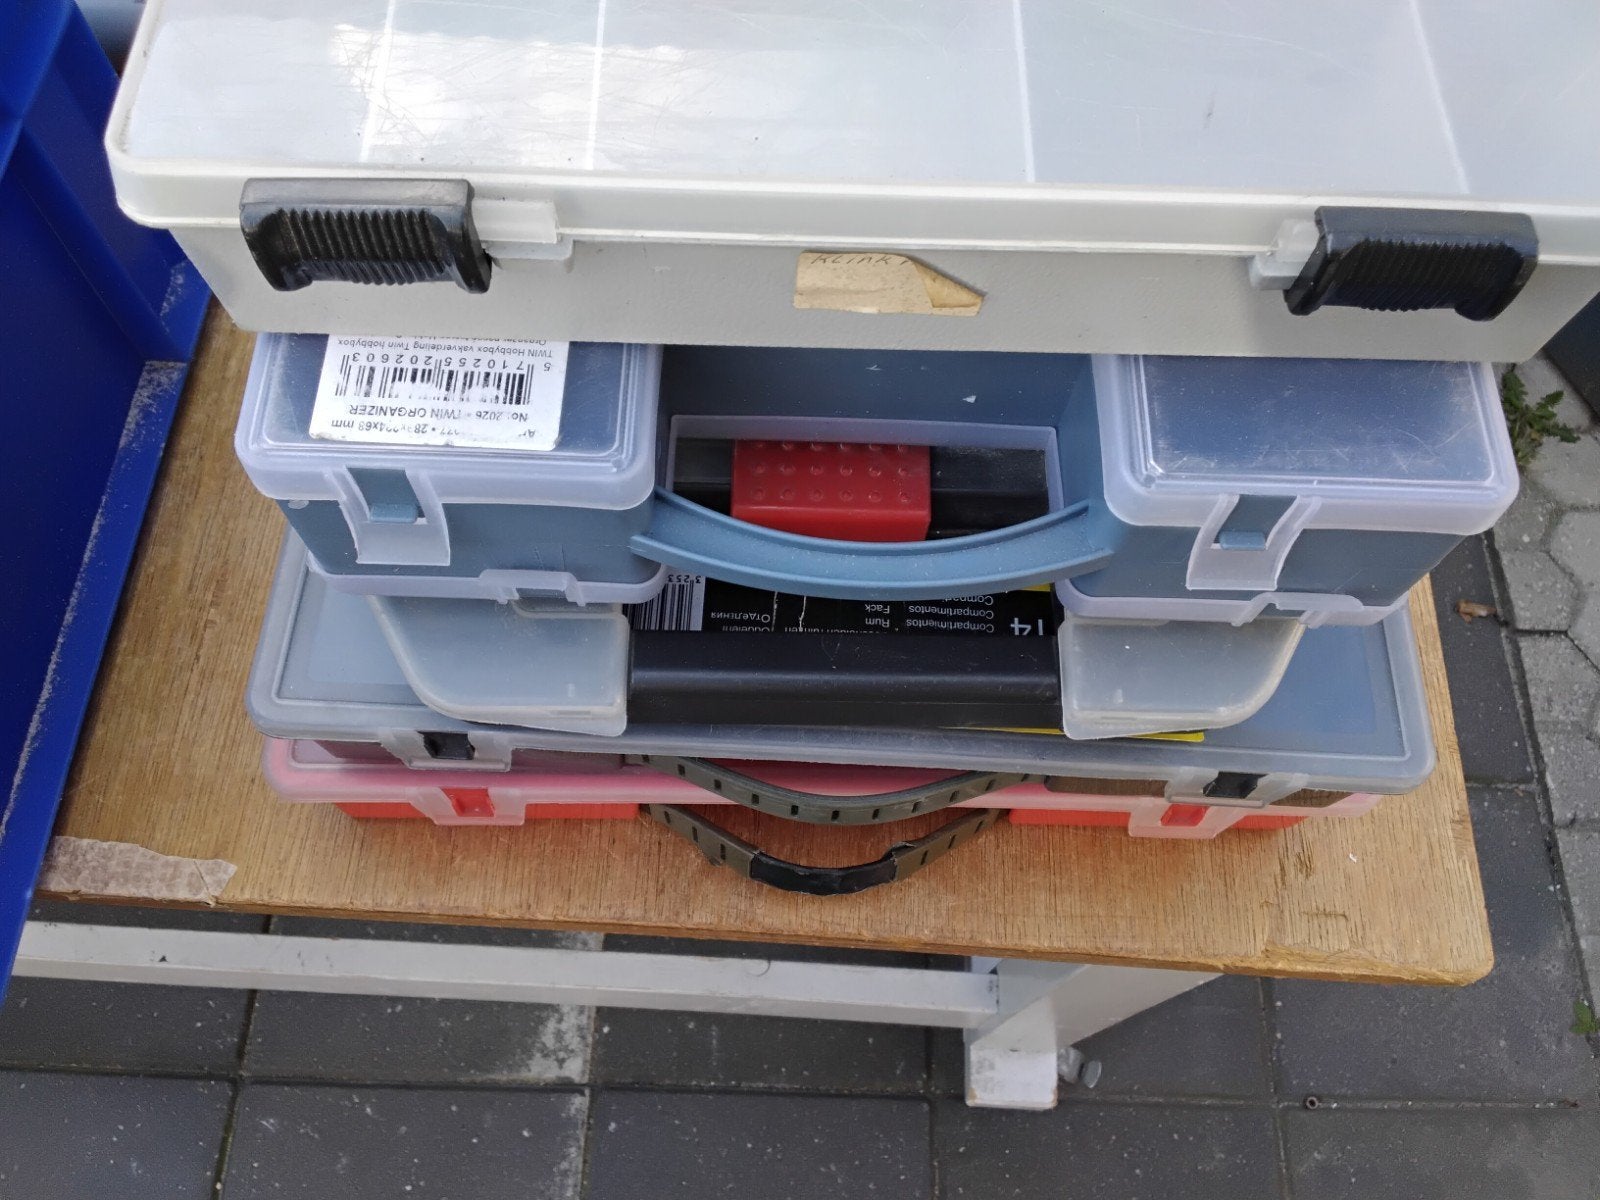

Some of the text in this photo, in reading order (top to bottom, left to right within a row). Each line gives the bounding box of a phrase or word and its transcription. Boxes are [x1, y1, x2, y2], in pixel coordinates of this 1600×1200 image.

[338, 338, 385, 350] hobbybox
[388, 341, 410, 351] Twin
[413, 341, 473, 355] vakverdeling
[477, 345, 525, 357] Hobbybox
[528, 349, 552, 358] TWIN
[543, 362, 552, 372] 5
[349, 404, 427, 418] ORGANIZER
[331, 419, 354, 428] mm
[865, 603, 890, 614] Fack
[908, 605, 994, 620] Compartimentos
[711, 611, 771, 624] Отделения
[865, 617, 890, 628] Rum
[905, 619, 994, 634] Compartimientos
